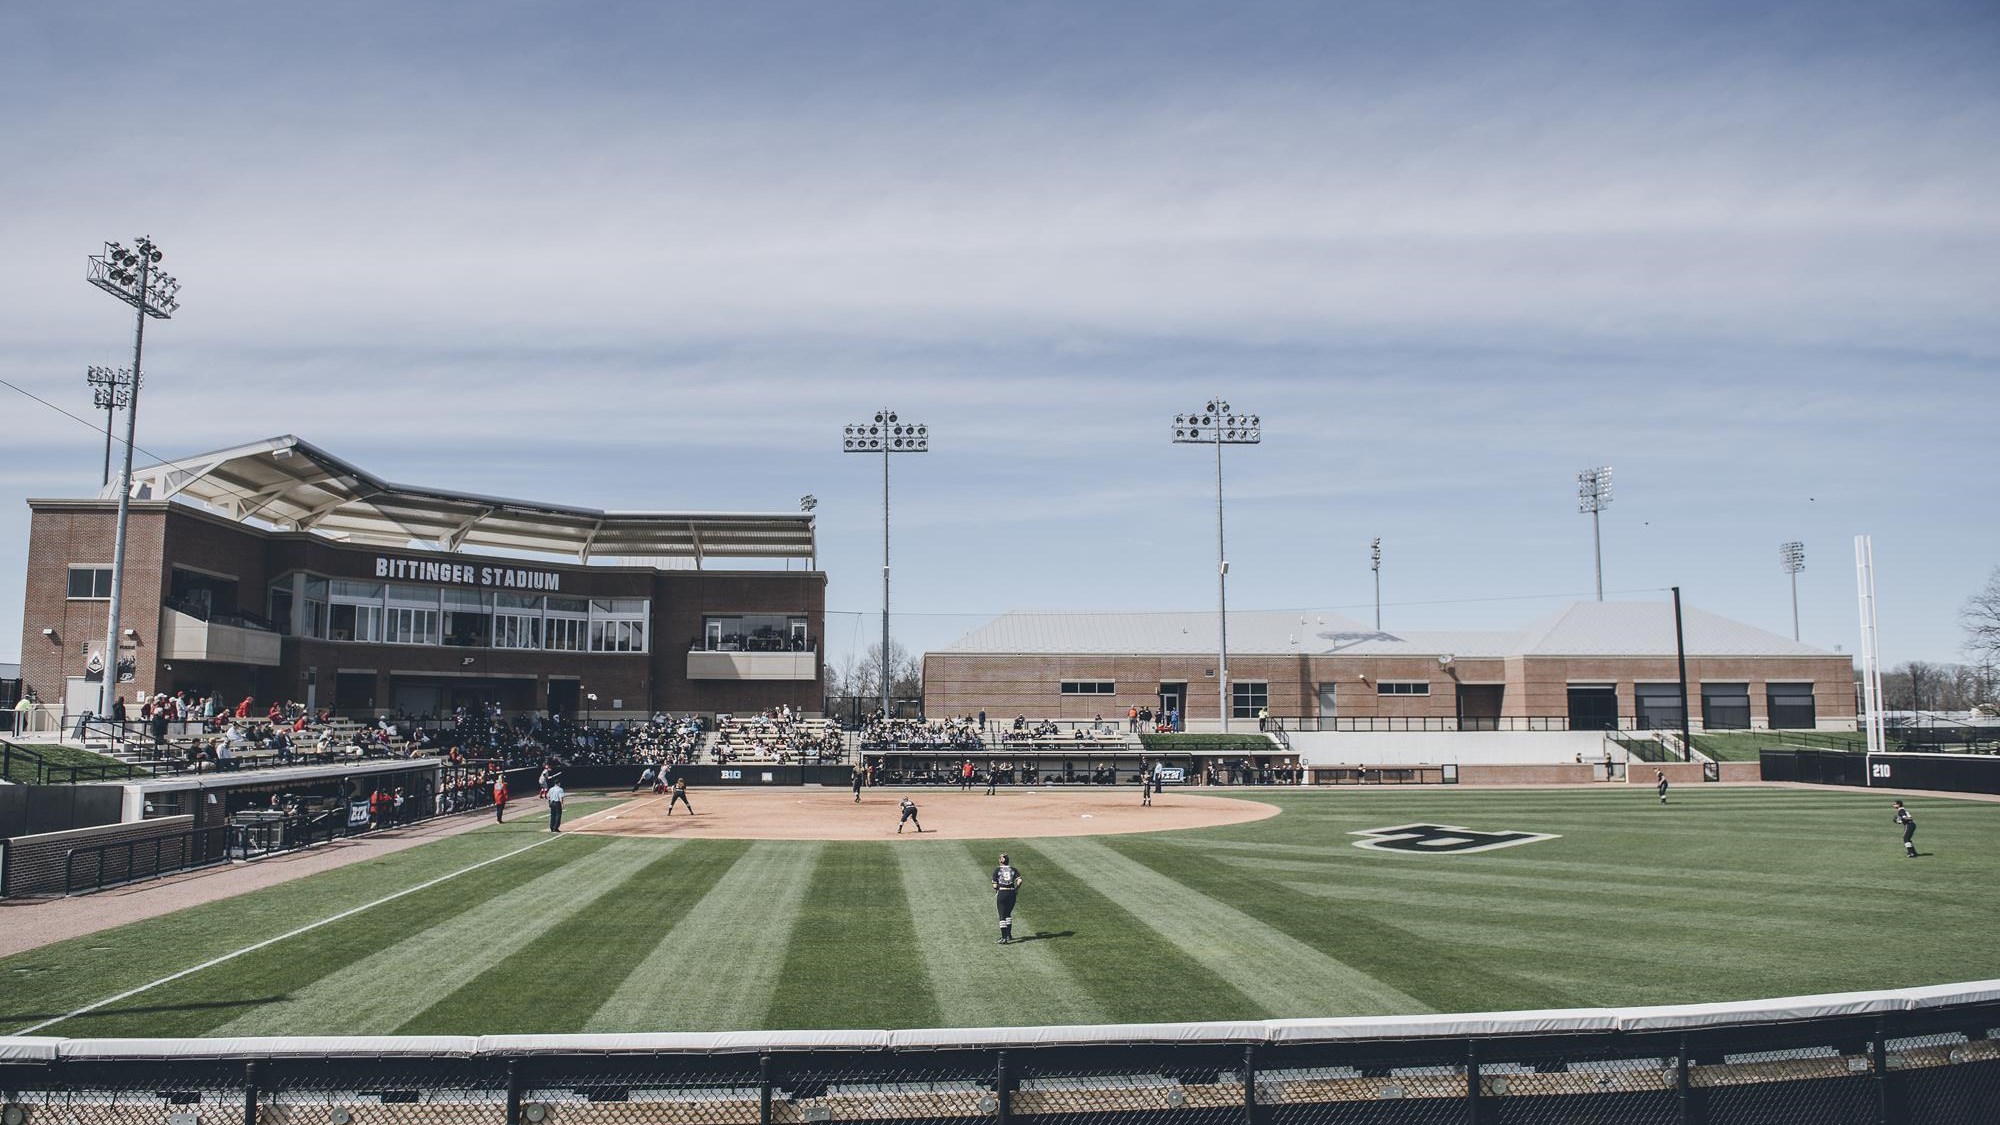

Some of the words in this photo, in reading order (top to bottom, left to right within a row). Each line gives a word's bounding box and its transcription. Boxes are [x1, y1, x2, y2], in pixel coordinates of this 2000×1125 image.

[375, 557, 475, 583] BITTINGER
[481, 567, 560, 591] STADIUM
[462, 657, 475, 665] P
[1872, 764, 1891, 778] 210
